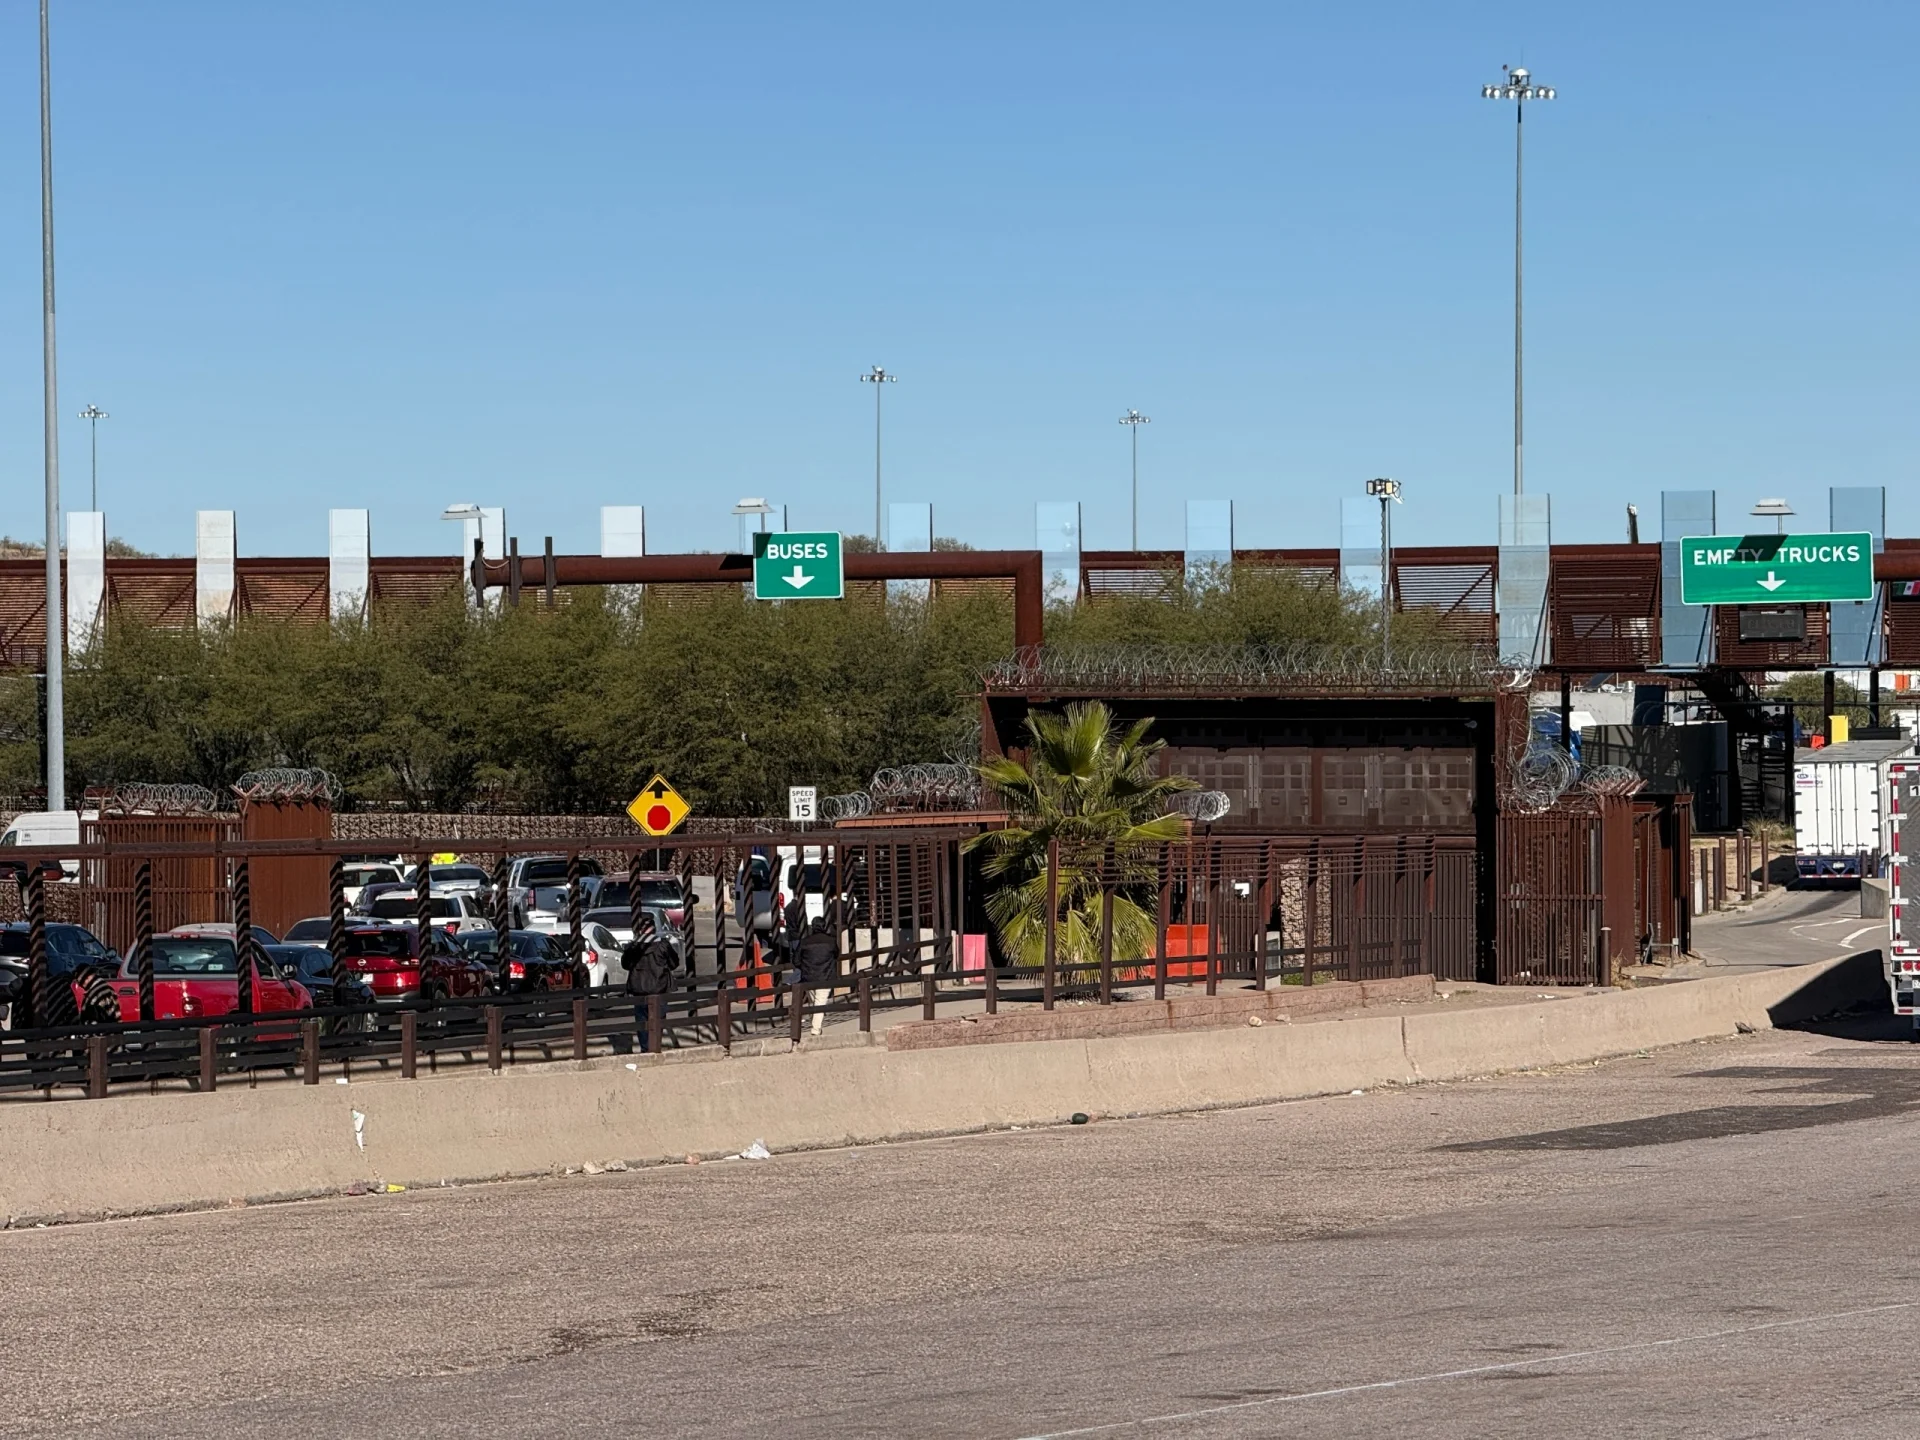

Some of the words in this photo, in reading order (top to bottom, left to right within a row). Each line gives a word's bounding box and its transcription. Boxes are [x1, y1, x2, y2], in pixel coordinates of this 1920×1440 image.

[767, 543, 828, 559] BUSES
[1693, 548, 1764, 566] EMPTY
[1777, 546, 1860, 563] TRUCKS
[1360, 672, 1403, 686] PORT
[1434, 672, 1488, 686] ENTRY
[795, 804, 811, 817] 15
